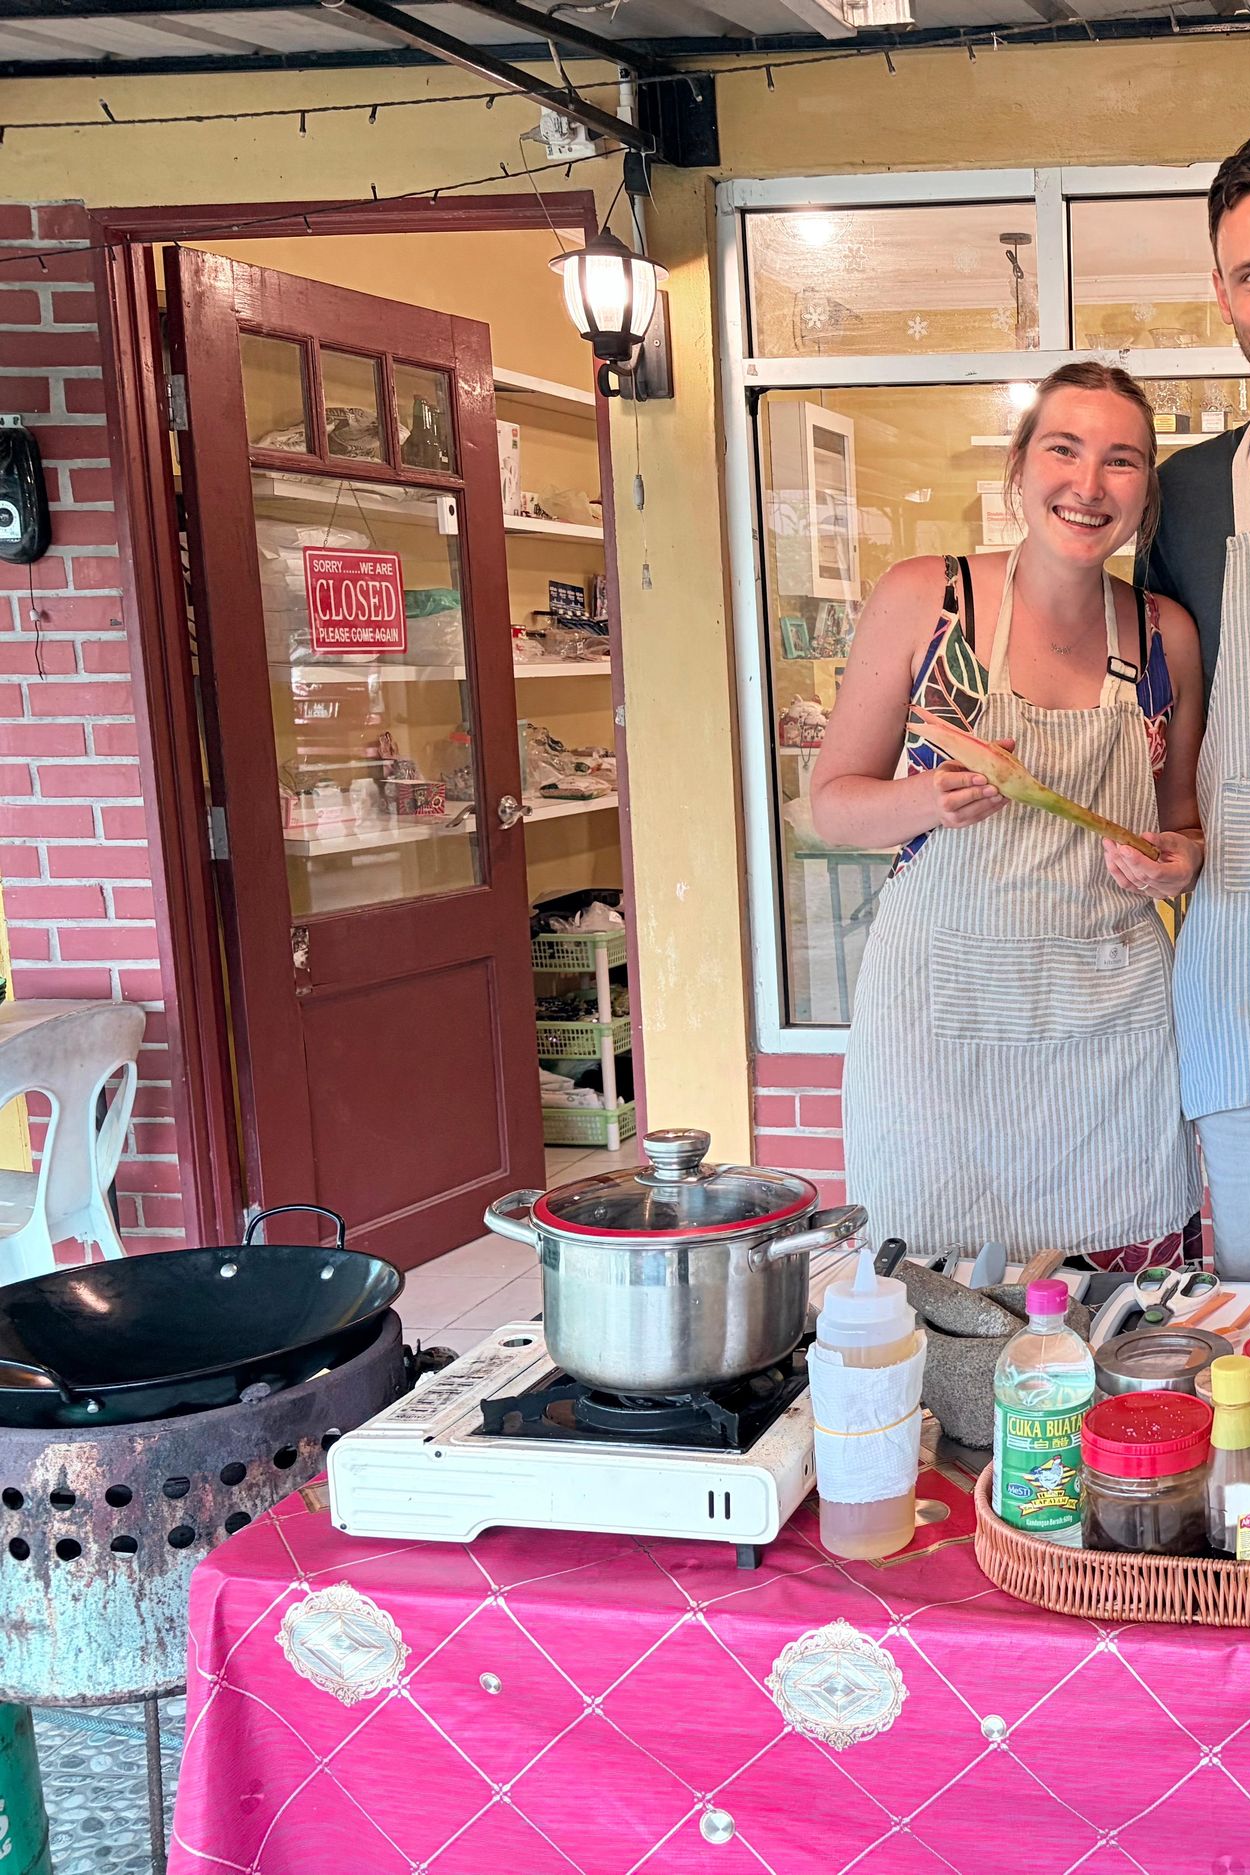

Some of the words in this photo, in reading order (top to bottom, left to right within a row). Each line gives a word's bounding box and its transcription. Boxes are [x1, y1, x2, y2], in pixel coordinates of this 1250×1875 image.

[375, 563, 393, 575] ARE
[316, 579, 397, 621] CLOSED
[320, 627, 350, 642] PLEASE
[351, 627, 373, 642] COME
[375, 627, 399, 642] AGAIN
[1009, 1418, 1042, 1437] CUKA
[1046, 1412, 1084, 1437] BUATA
